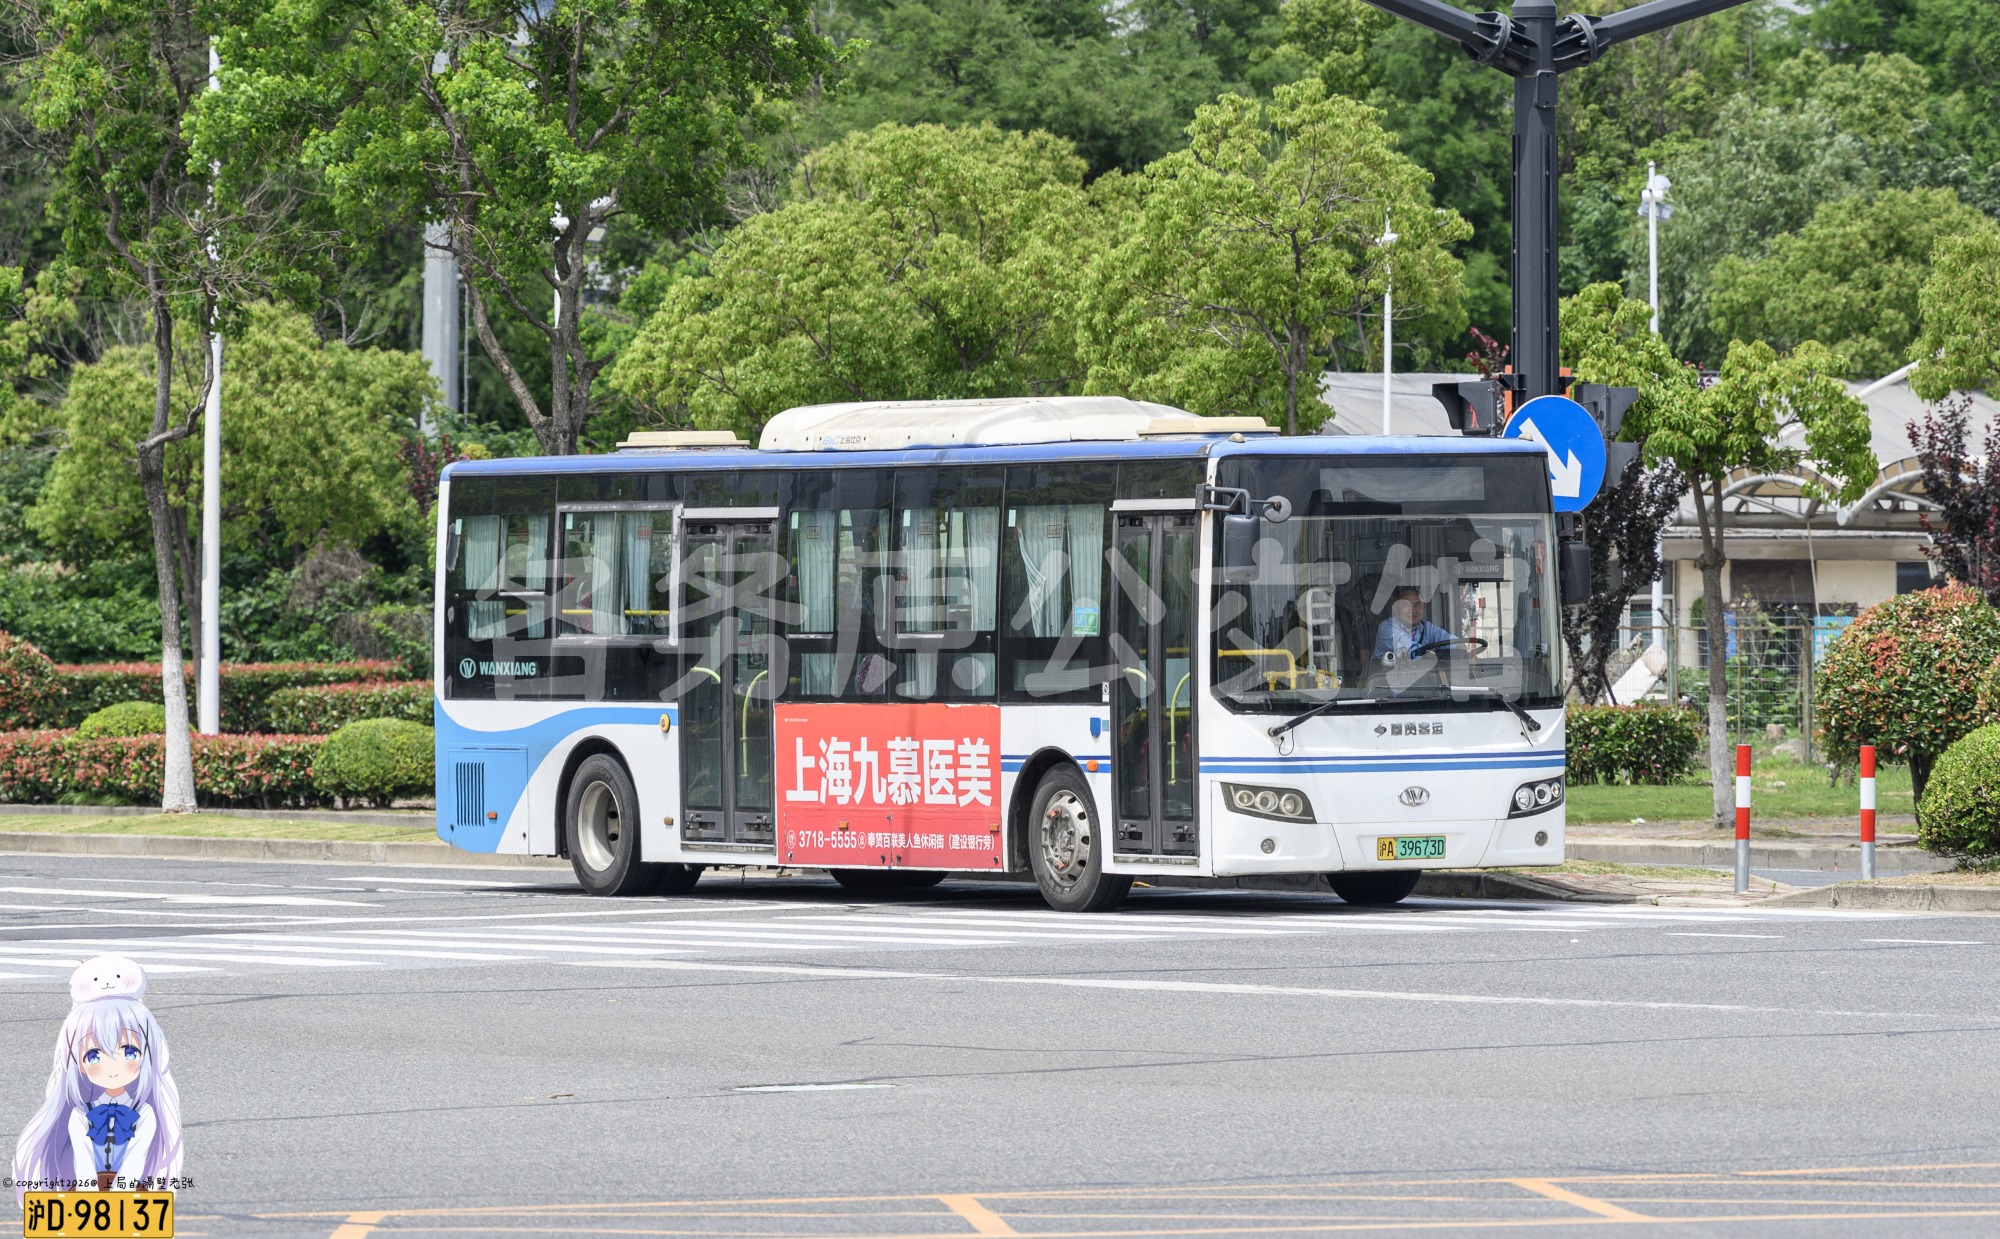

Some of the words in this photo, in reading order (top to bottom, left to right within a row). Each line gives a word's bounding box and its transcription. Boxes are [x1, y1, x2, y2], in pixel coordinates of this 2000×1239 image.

[479, 661, 537, 675] WANXIANG
[786, 736, 992, 807] 上海九慕医美
[799, 830, 857, 848] 3718-5555
[1400, 839, 1445, 857] 39673D
